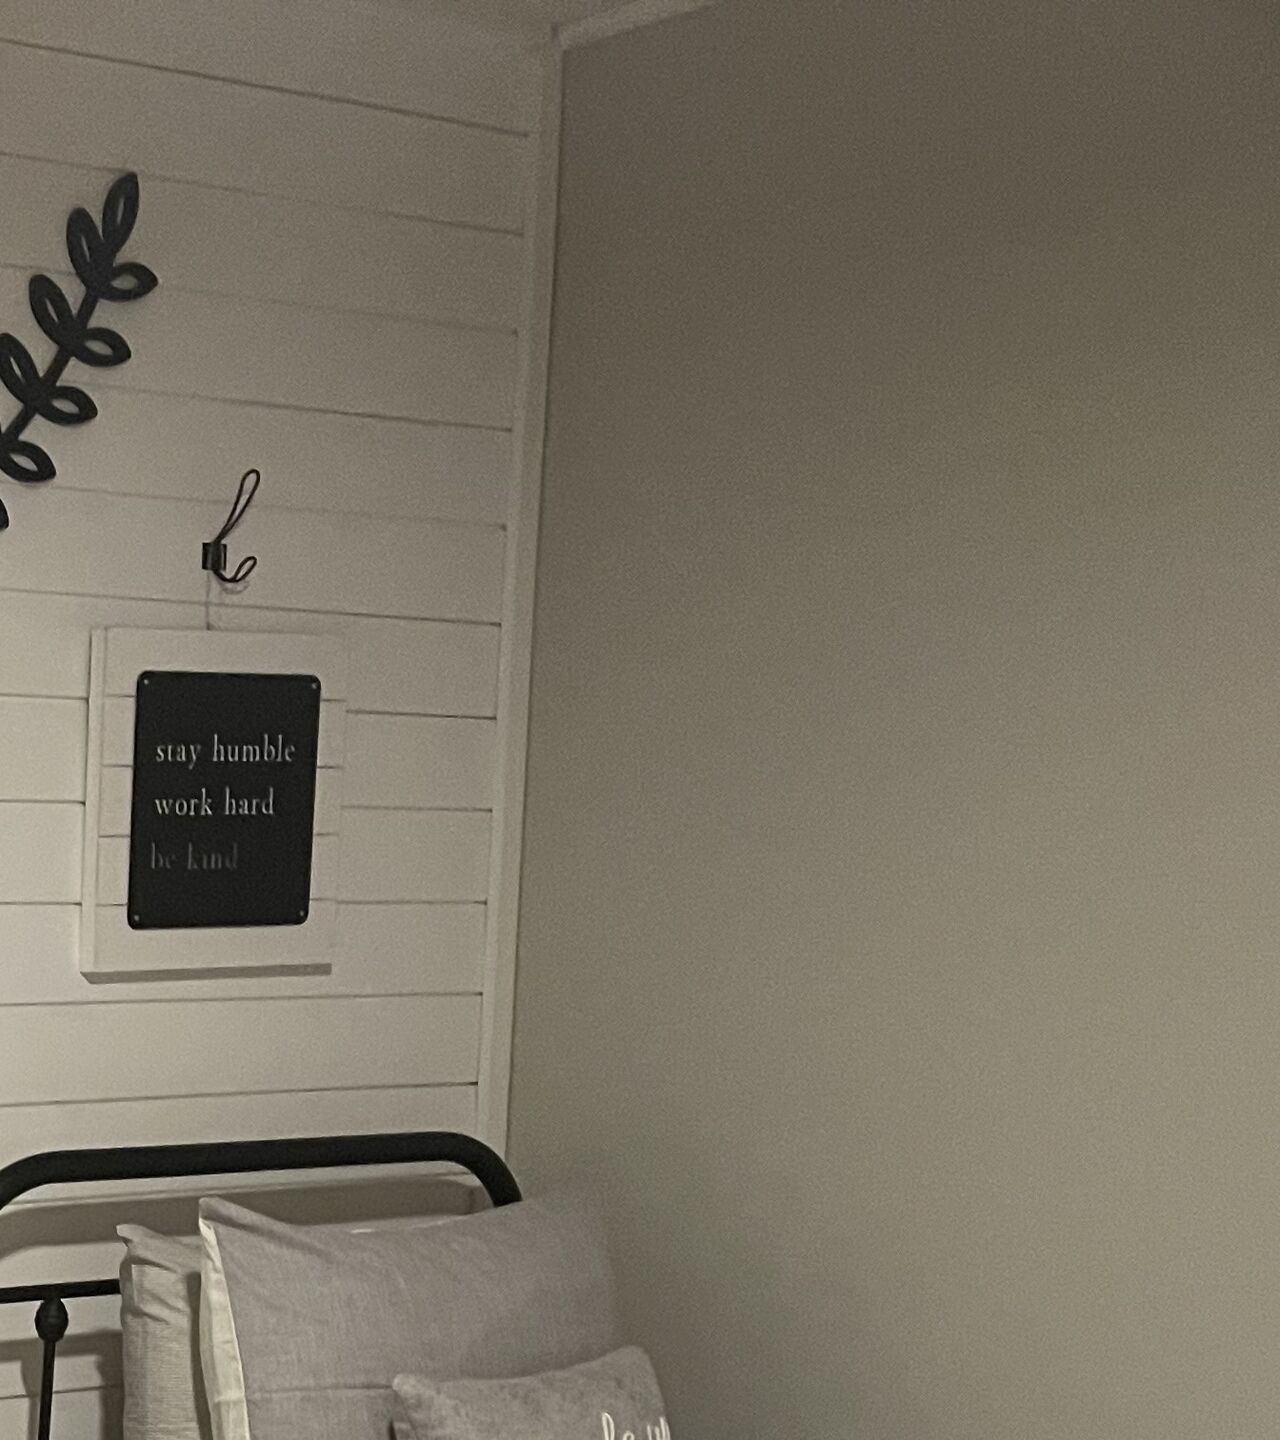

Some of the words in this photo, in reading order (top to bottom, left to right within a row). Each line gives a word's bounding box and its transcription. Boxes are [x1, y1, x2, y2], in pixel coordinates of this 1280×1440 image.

[155, 743, 201, 770] stay
[212, 733, 296, 763] humble
[154, 787, 213, 816] work
[224, 786, 276, 816] hard
[150, 842, 177, 870] be
[187, 841, 239, 871] kind
